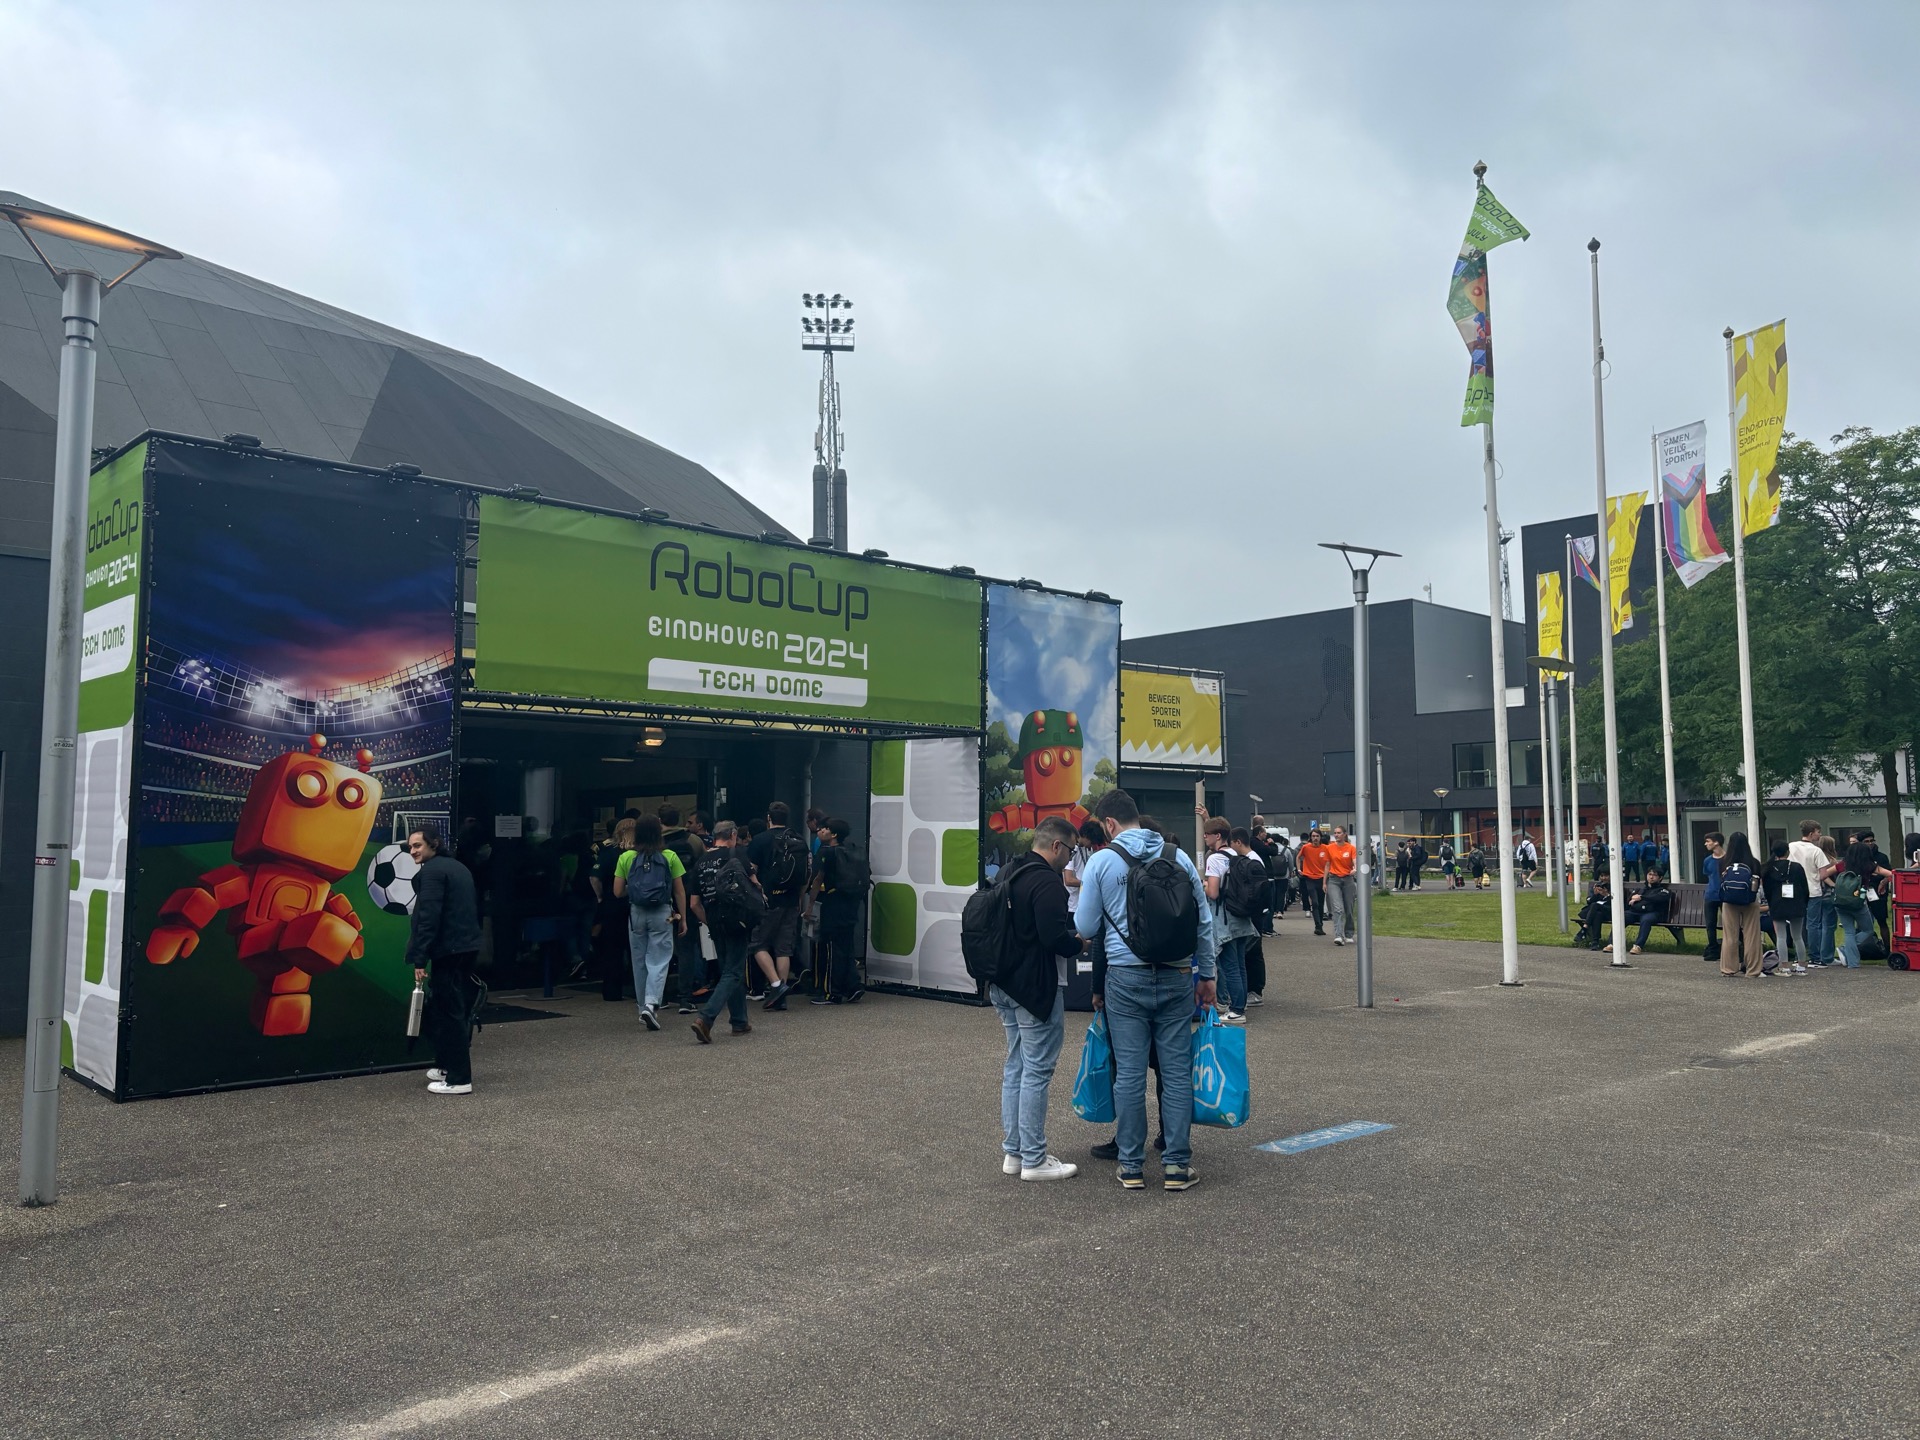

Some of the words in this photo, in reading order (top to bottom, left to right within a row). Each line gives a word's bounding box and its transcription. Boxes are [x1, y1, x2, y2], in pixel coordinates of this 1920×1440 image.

[1467, 229, 1488, 242] JULY
[1481, 220, 1508, 240] 2024
[1738, 415, 1783, 437] EINDHOVEN
[1663, 432, 1690, 447] SAMEN
[1665, 450, 1698, 467] SPORTEN
[86, 498, 139, 555] oboCup
[108, 552, 138, 588] 2024
[649, 541, 870, 632] RoboCup
[102, 625, 126, 652] DOME
[648, 615, 780, 651] EINDHOVEN
[783, 633, 869, 671] 2024
[698, 668, 755, 693] TECH
[766, 675, 824, 698] DOME
[1148, 693, 1181, 705] BEWEGEN
[1151, 706, 1181, 717] SPORTEN
[1153, 719, 1182, 729] TRAINEN
